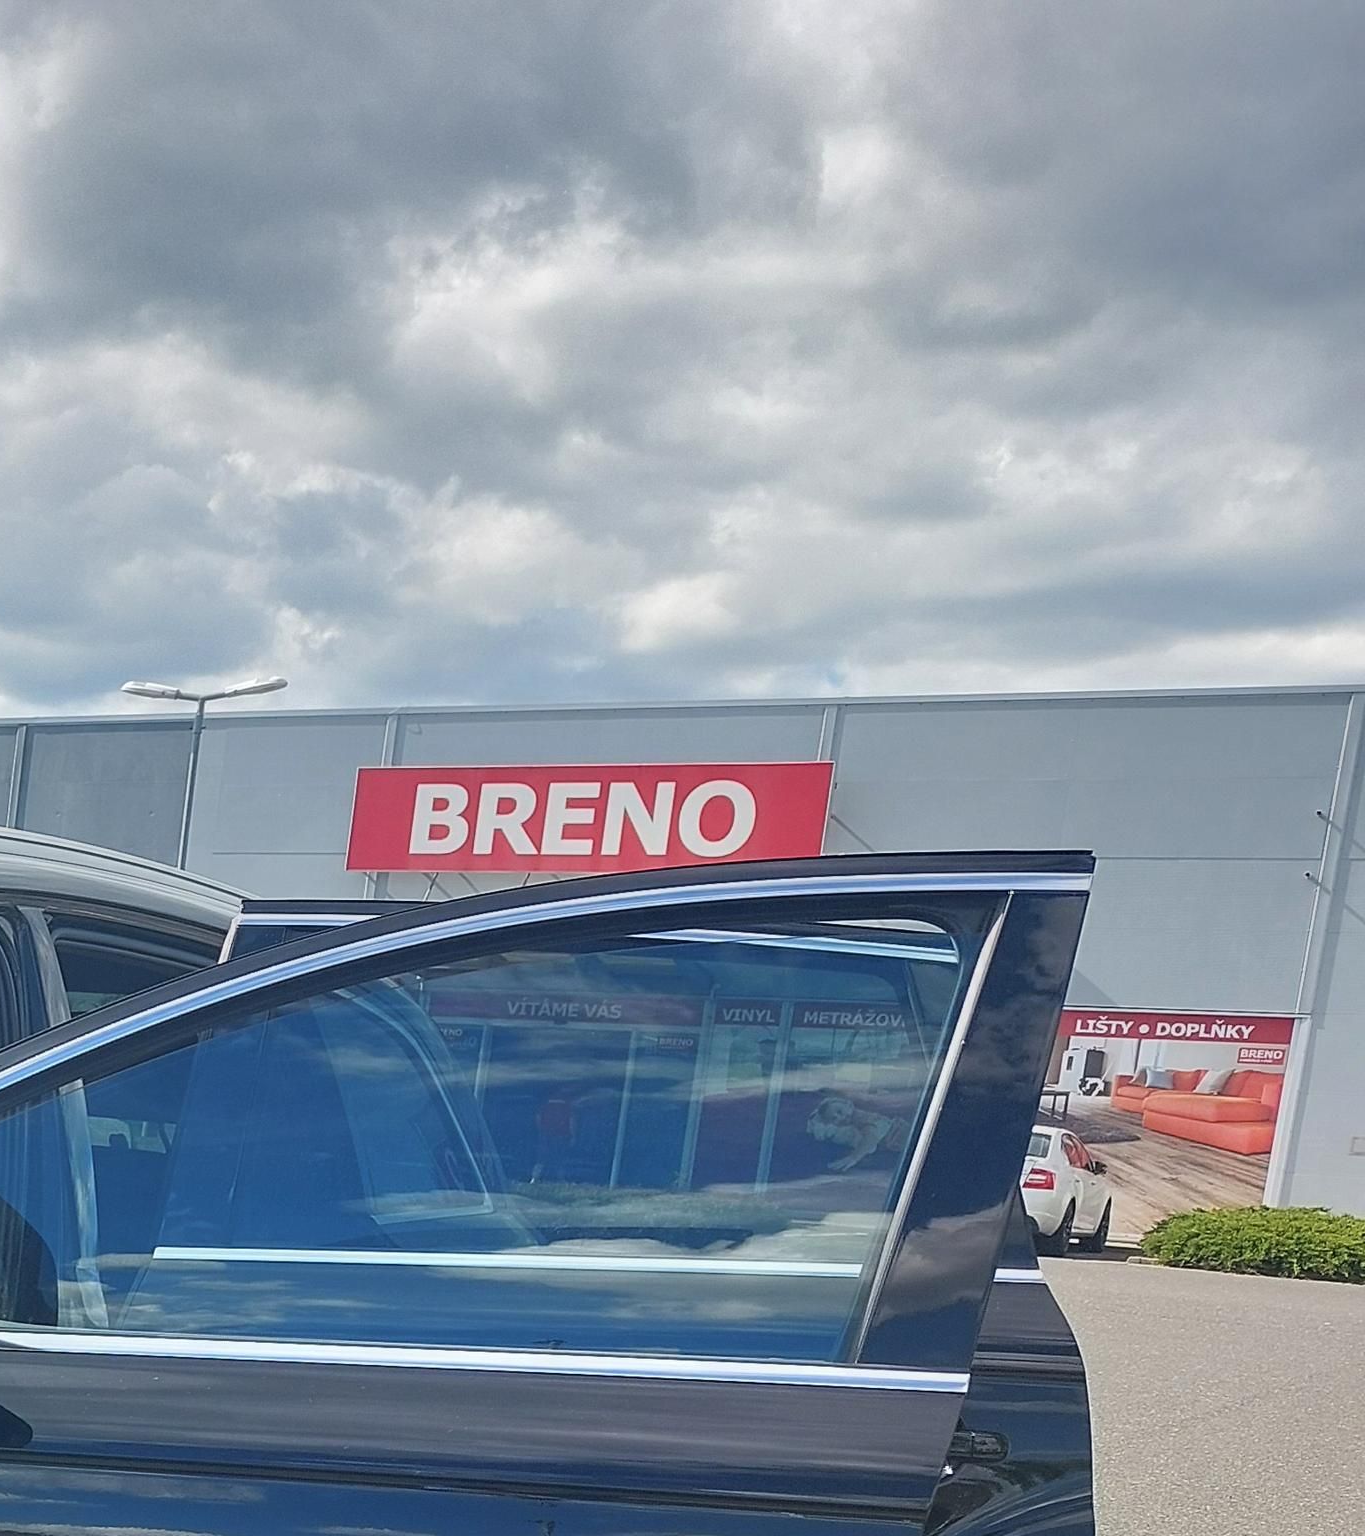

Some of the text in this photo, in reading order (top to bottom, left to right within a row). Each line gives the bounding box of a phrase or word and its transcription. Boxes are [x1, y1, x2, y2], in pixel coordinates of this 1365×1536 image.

[408, 779, 757, 858] BRENO
[506, 997, 622, 1019] VÍTÁME VÁS
[722, 1008, 775, 1024] VINYL
[1075, 1016, 1256, 1039] LIŠTY DOPLŇKY
[1240, 1048, 1284, 1060] BRENO
